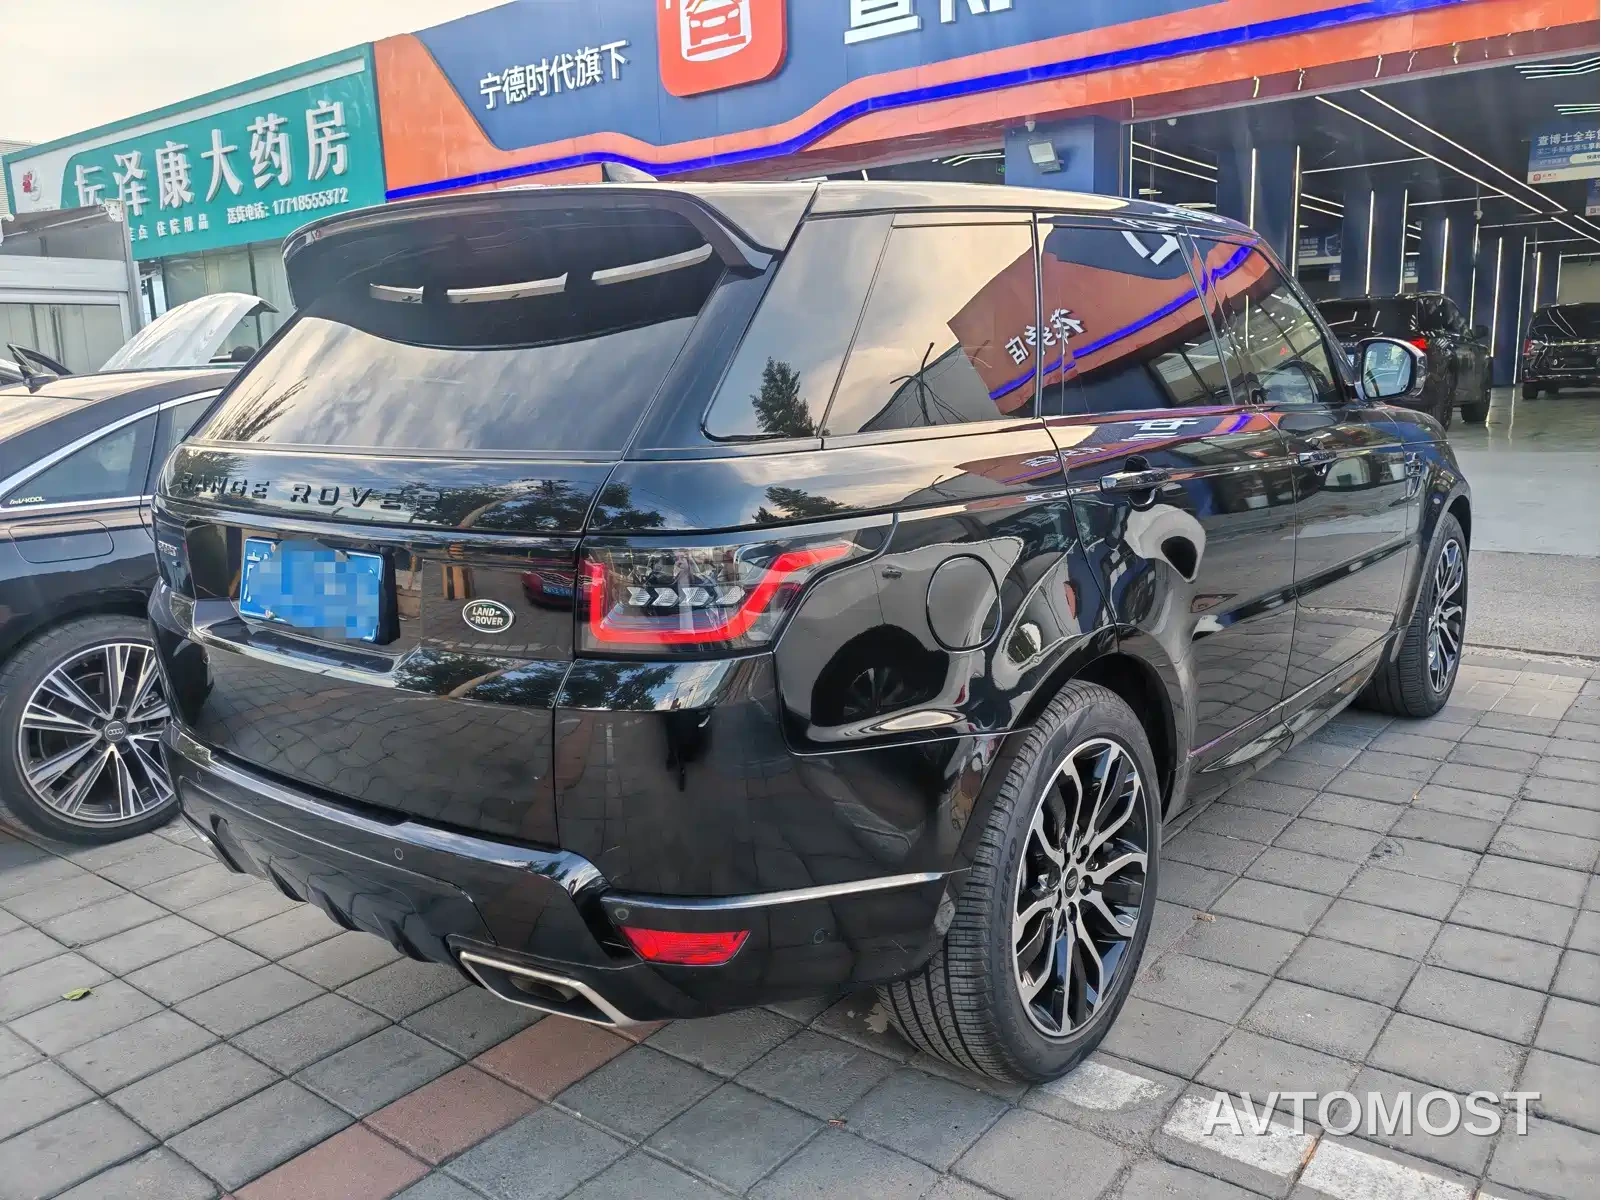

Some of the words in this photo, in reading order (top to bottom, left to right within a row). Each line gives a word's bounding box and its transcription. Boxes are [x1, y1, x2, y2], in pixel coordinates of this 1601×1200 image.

[479, 39, 631, 110] 宁德时代旗下
[180, 472, 271, 499] RANGE
[289, 483, 443, 510] ROVER
[472, 606, 495, 617] LAND
[475, 615, 504, 626] ROVER
